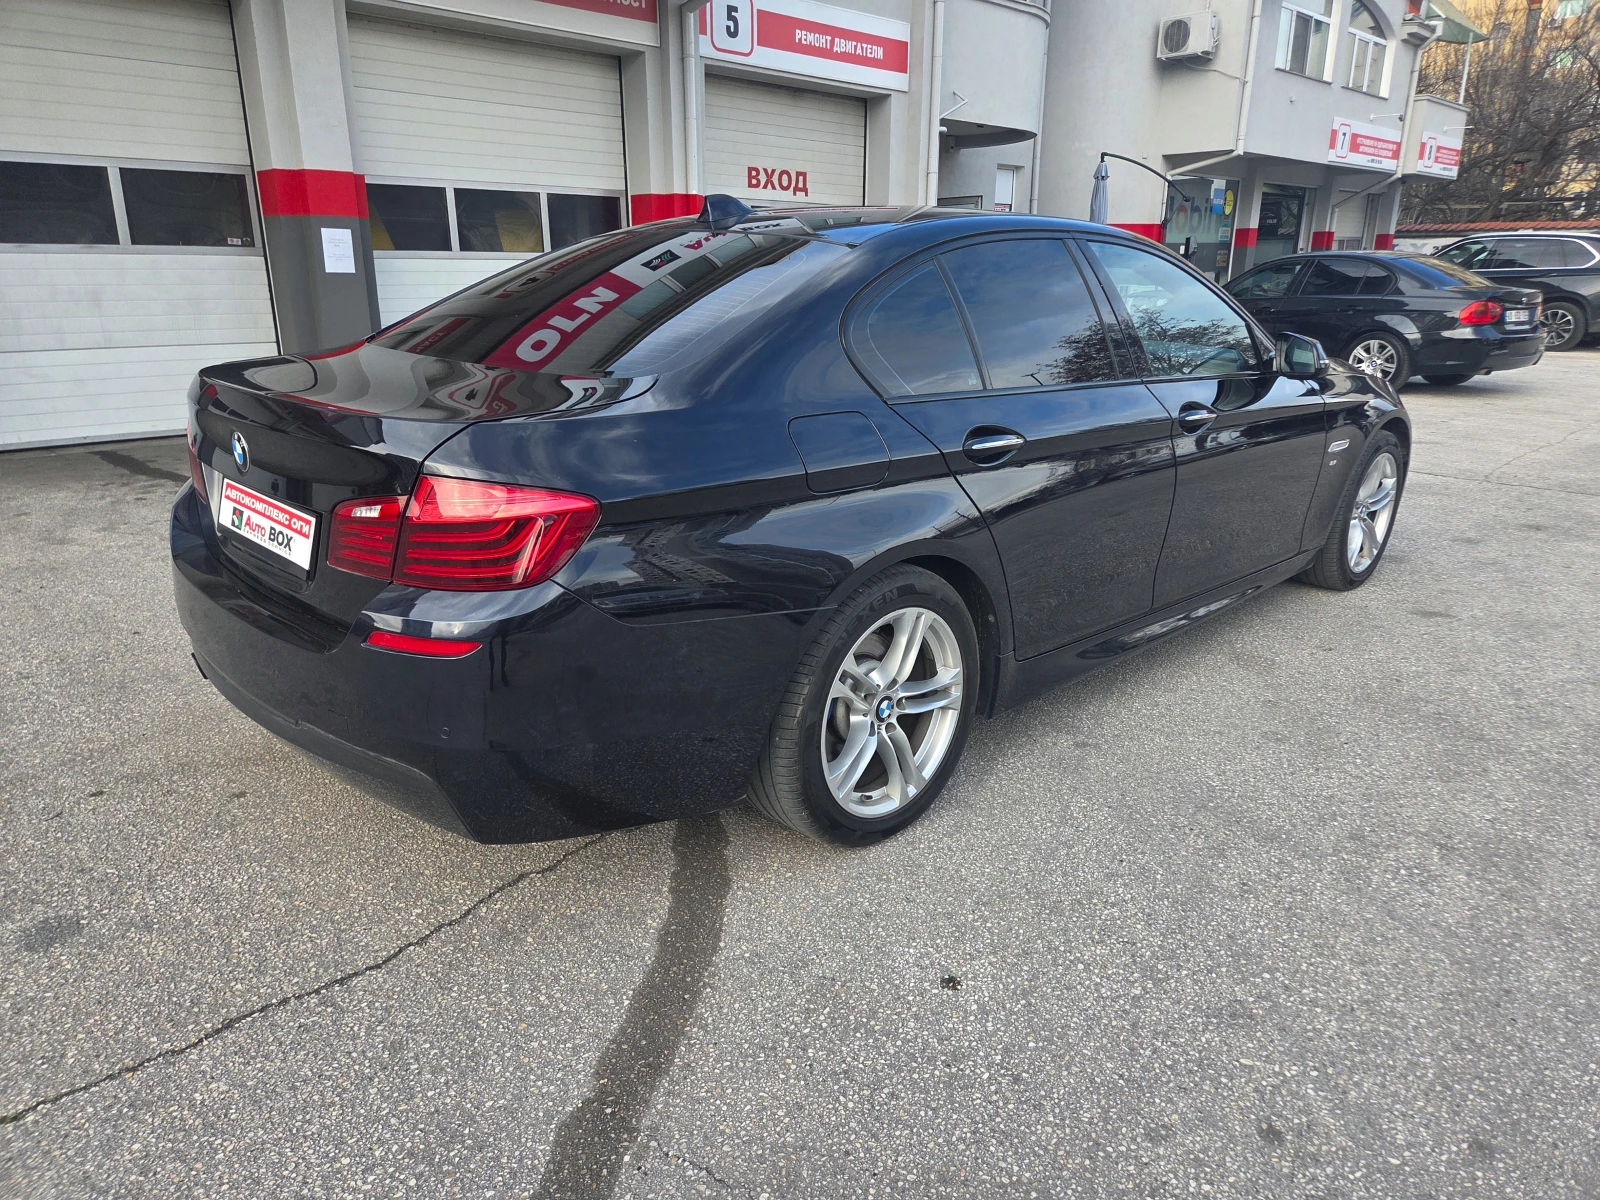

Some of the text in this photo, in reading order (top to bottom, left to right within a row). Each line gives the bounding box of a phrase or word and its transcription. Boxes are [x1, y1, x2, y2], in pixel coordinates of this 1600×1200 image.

[725, 4, 739, 39] 5
[795, 29, 883, 60] РЕМОНТ ДВИГАТЕЛИ
[1340, 132, 1347, 151] 7
[747, 166, 809, 197] ВХОД
[225, 487, 310, 536] АВТОКОМПЛЕКС ОГИ
[268, 525, 294, 552] BOX
[836, 588, 899, 649] NEXEN
